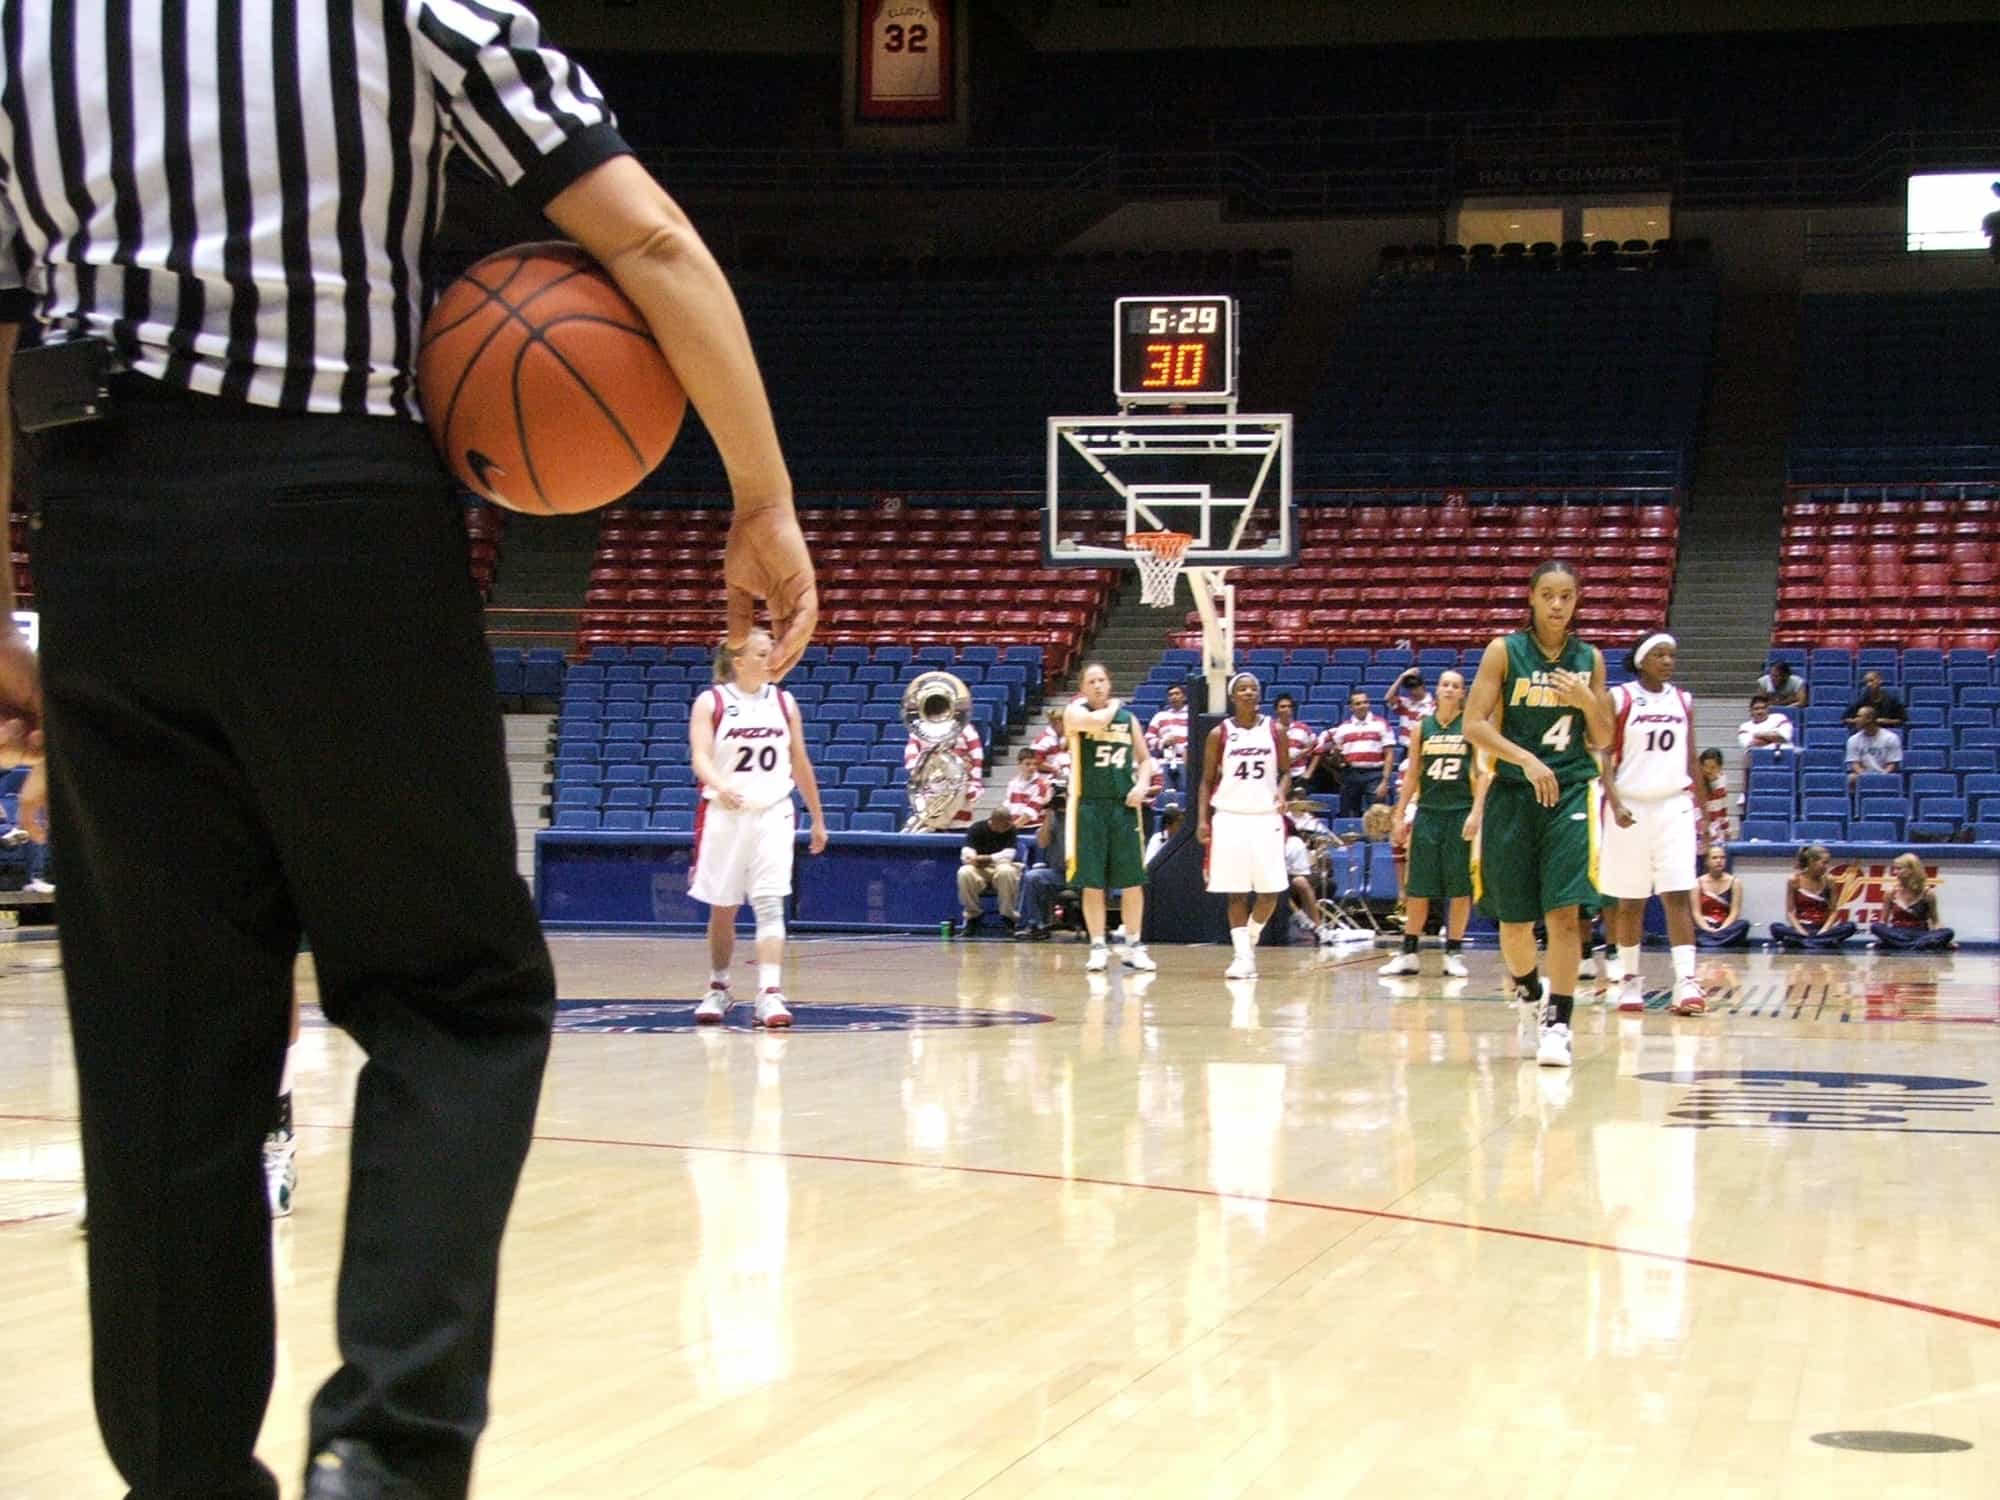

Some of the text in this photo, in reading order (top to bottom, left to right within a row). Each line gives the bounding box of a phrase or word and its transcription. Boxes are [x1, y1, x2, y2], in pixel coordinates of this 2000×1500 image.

[885, 24, 928, 53] 32
[1149, 307, 1217, 334] 5:29
[1143, 344, 1204, 386] 30
[882, 496, 901, 512] 20
[1541, 715, 1573, 751] 4
[1646, 729, 1675, 751] 10
[734, 746, 777, 772] 20
[1094, 745, 1128, 768] 54
[1234, 761, 1265, 780] 45
[1427, 758, 1462, 780] 42
